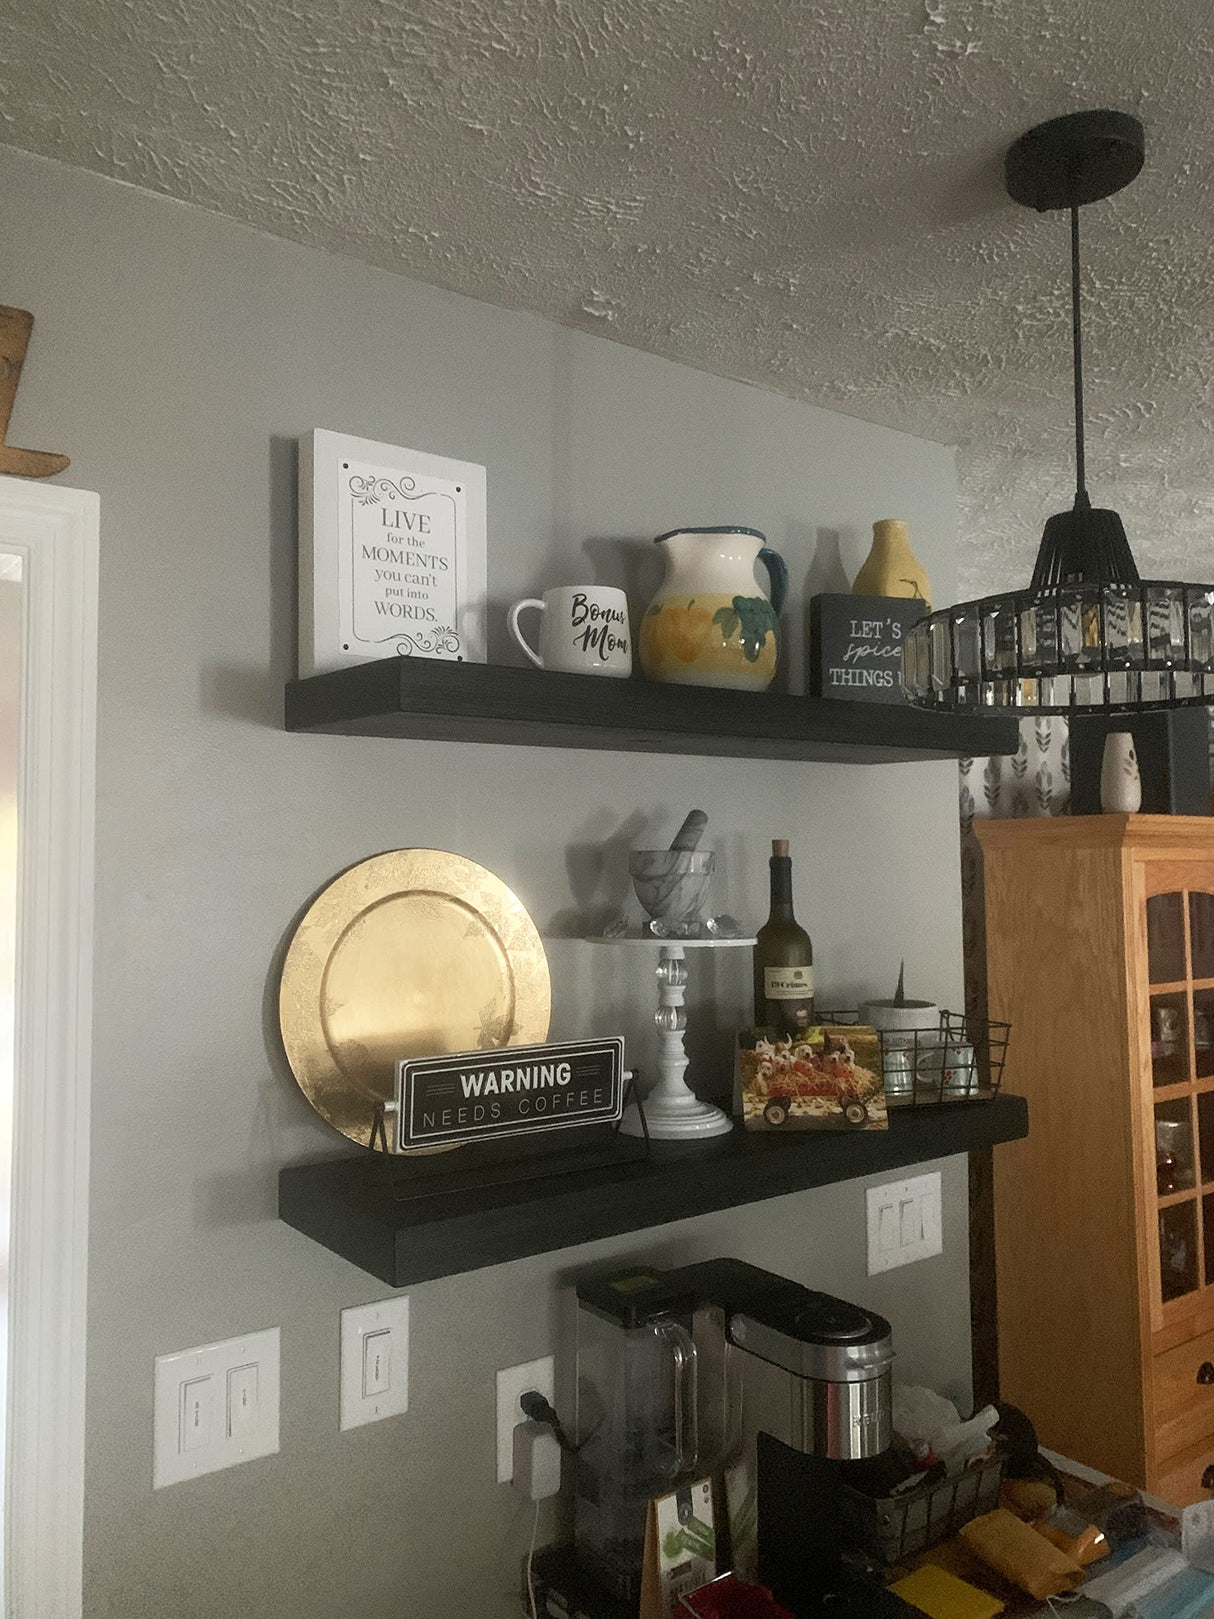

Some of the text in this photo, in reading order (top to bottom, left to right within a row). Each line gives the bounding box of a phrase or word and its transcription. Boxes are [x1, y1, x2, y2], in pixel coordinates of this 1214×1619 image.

[381, 507, 431, 534] LIVE
[387, 532, 425, 548] for the
[362, 545, 449, 571] MOMENTS
[374, 568, 438, 587] you can't
[385, 587, 429, 601] put into
[374, 600, 438, 622] WORDS.
[572, 593, 625, 627] Bonus
[849, 618, 901, 640] LET'S
[572, 624, 628, 661] Mom
[843, 641, 902, 664] spice
[829, 668, 894, 687] THINGS
[460, 1062, 572, 1098] WARNING
[423, 1088, 603, 1128] NEEDS COFFEE
